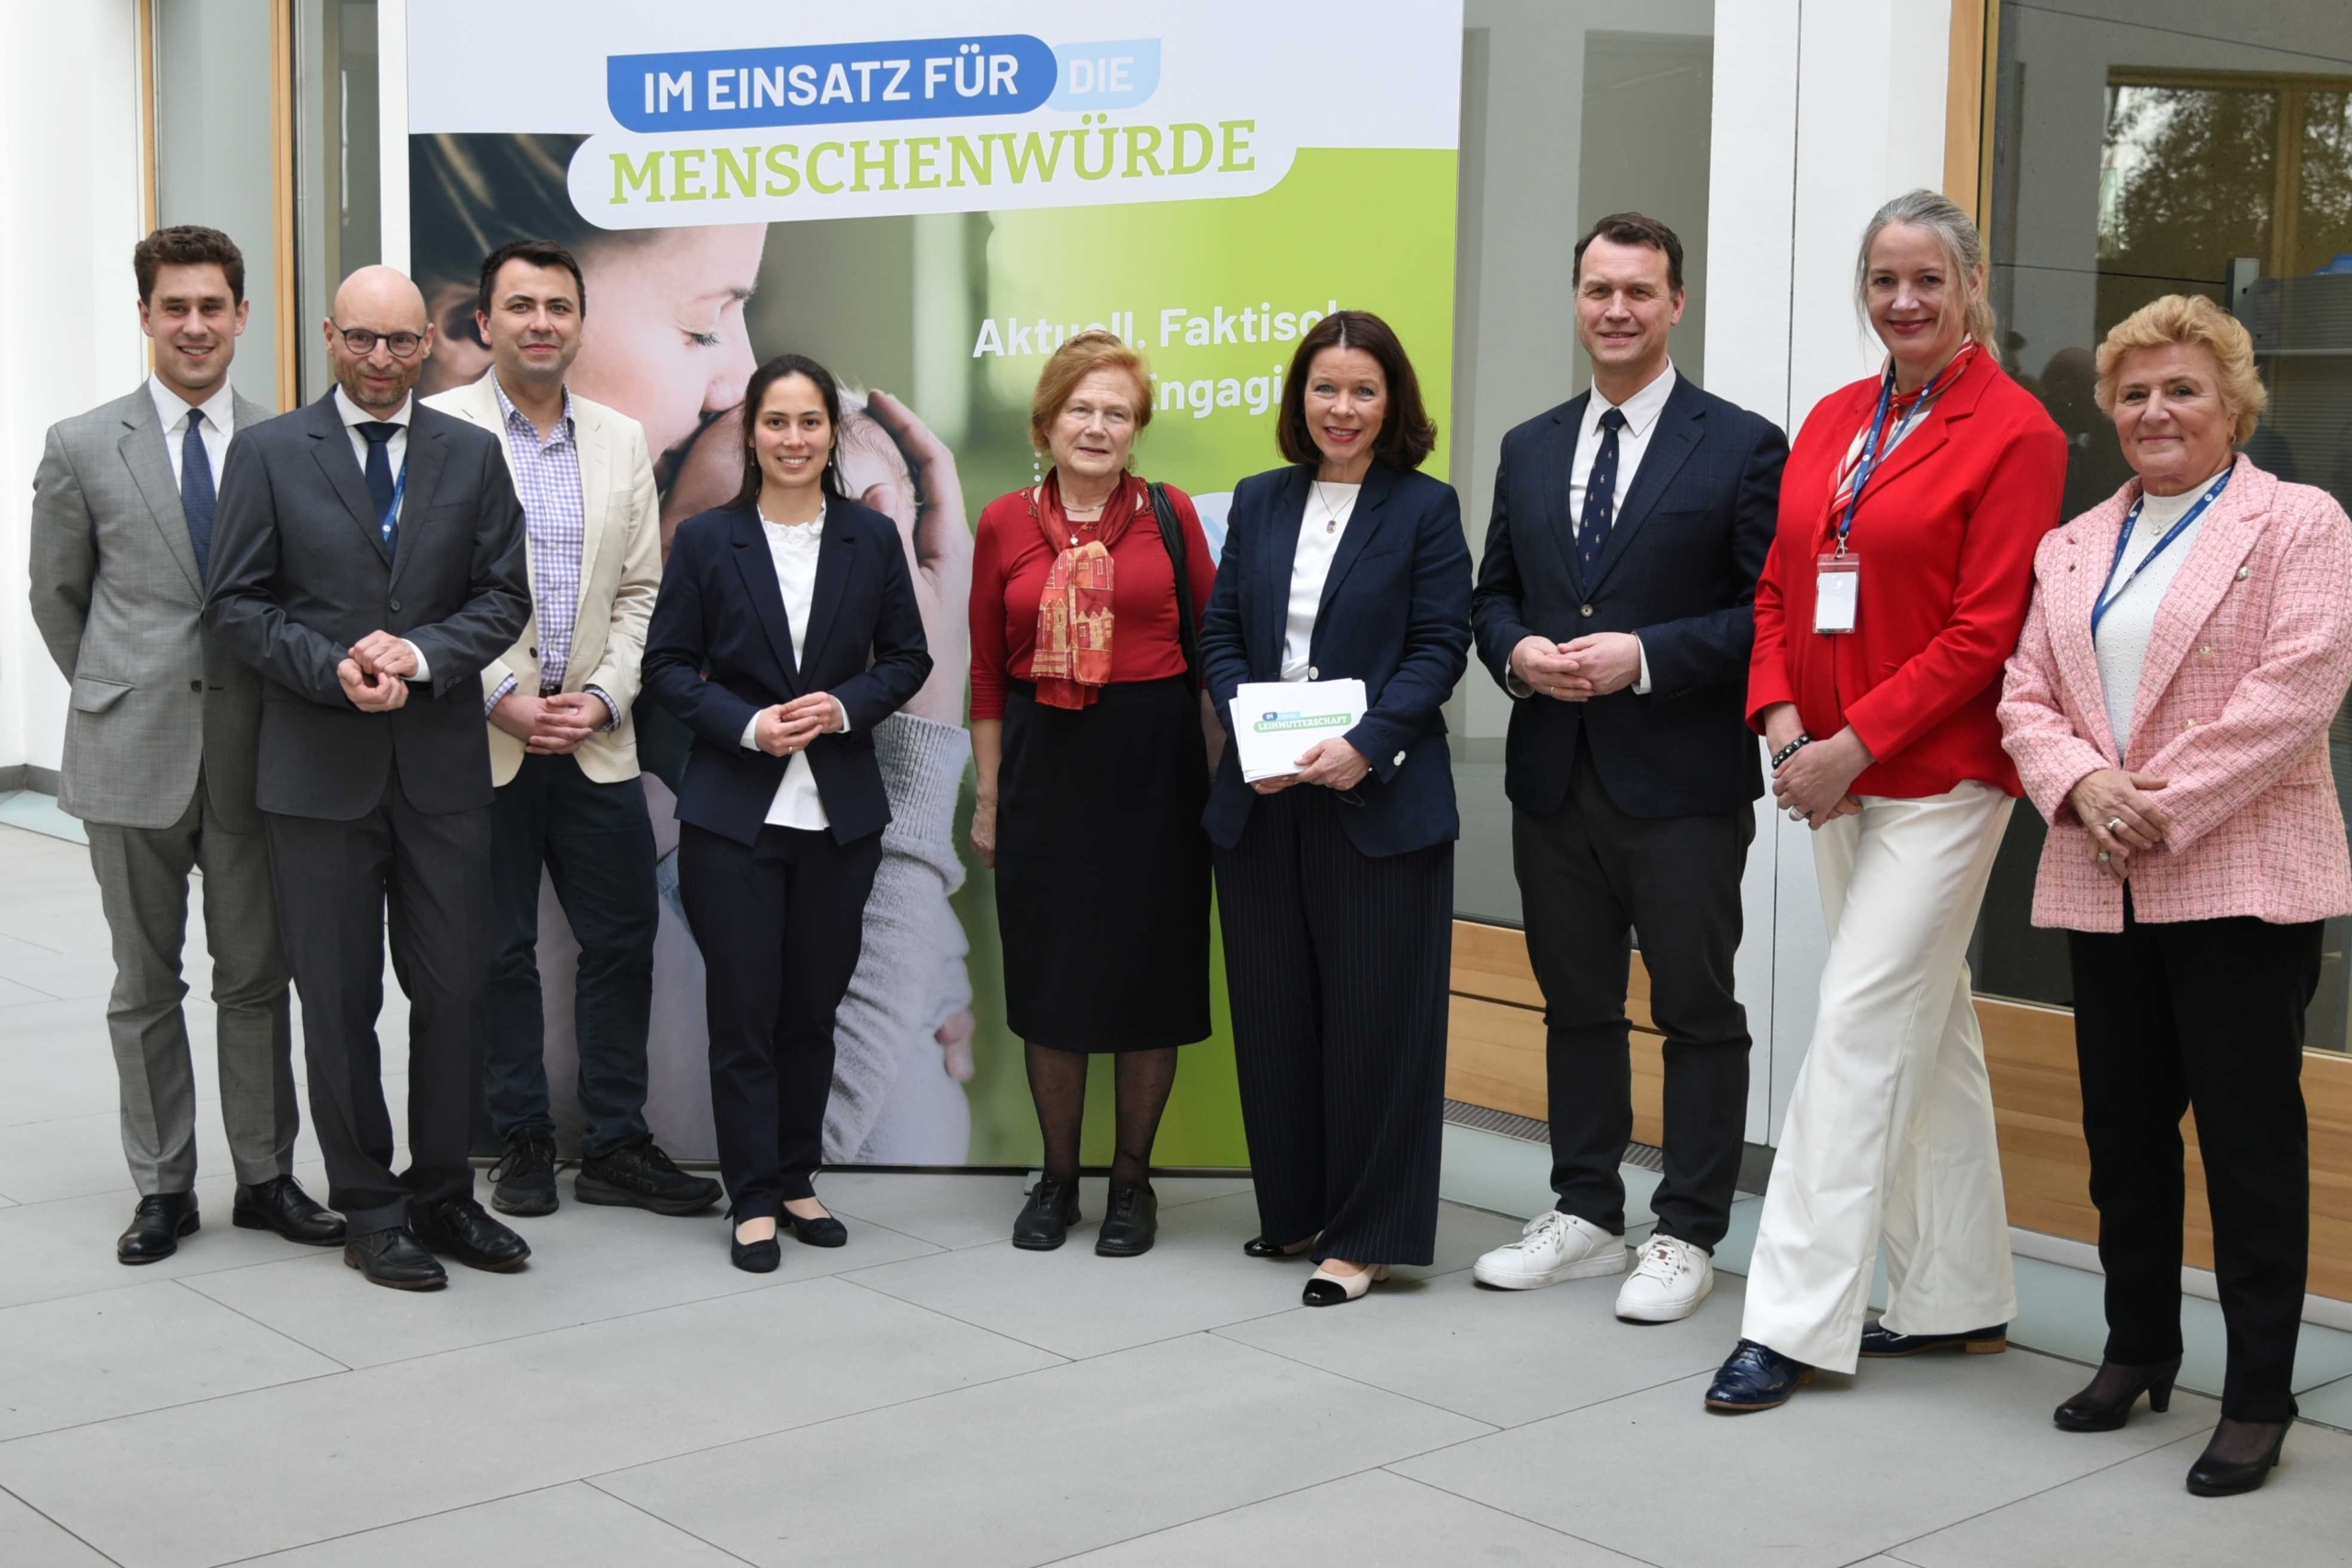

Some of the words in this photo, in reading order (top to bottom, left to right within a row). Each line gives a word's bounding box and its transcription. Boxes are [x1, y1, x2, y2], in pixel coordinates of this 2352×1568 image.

[645, 71, 692, 113] IM
[708, 59, 910, 111] EINSATZ
[924, 44, 1019, 99] FÜR
[1069, 58, 1134, 96] DIE
[611, 114, 1256, 204] MENSCHENWÜRDE
[973, 311, 1146, 357] Aktull.
[1259, 716, 1348, 730] LEIHMUTTERSCHAFT
